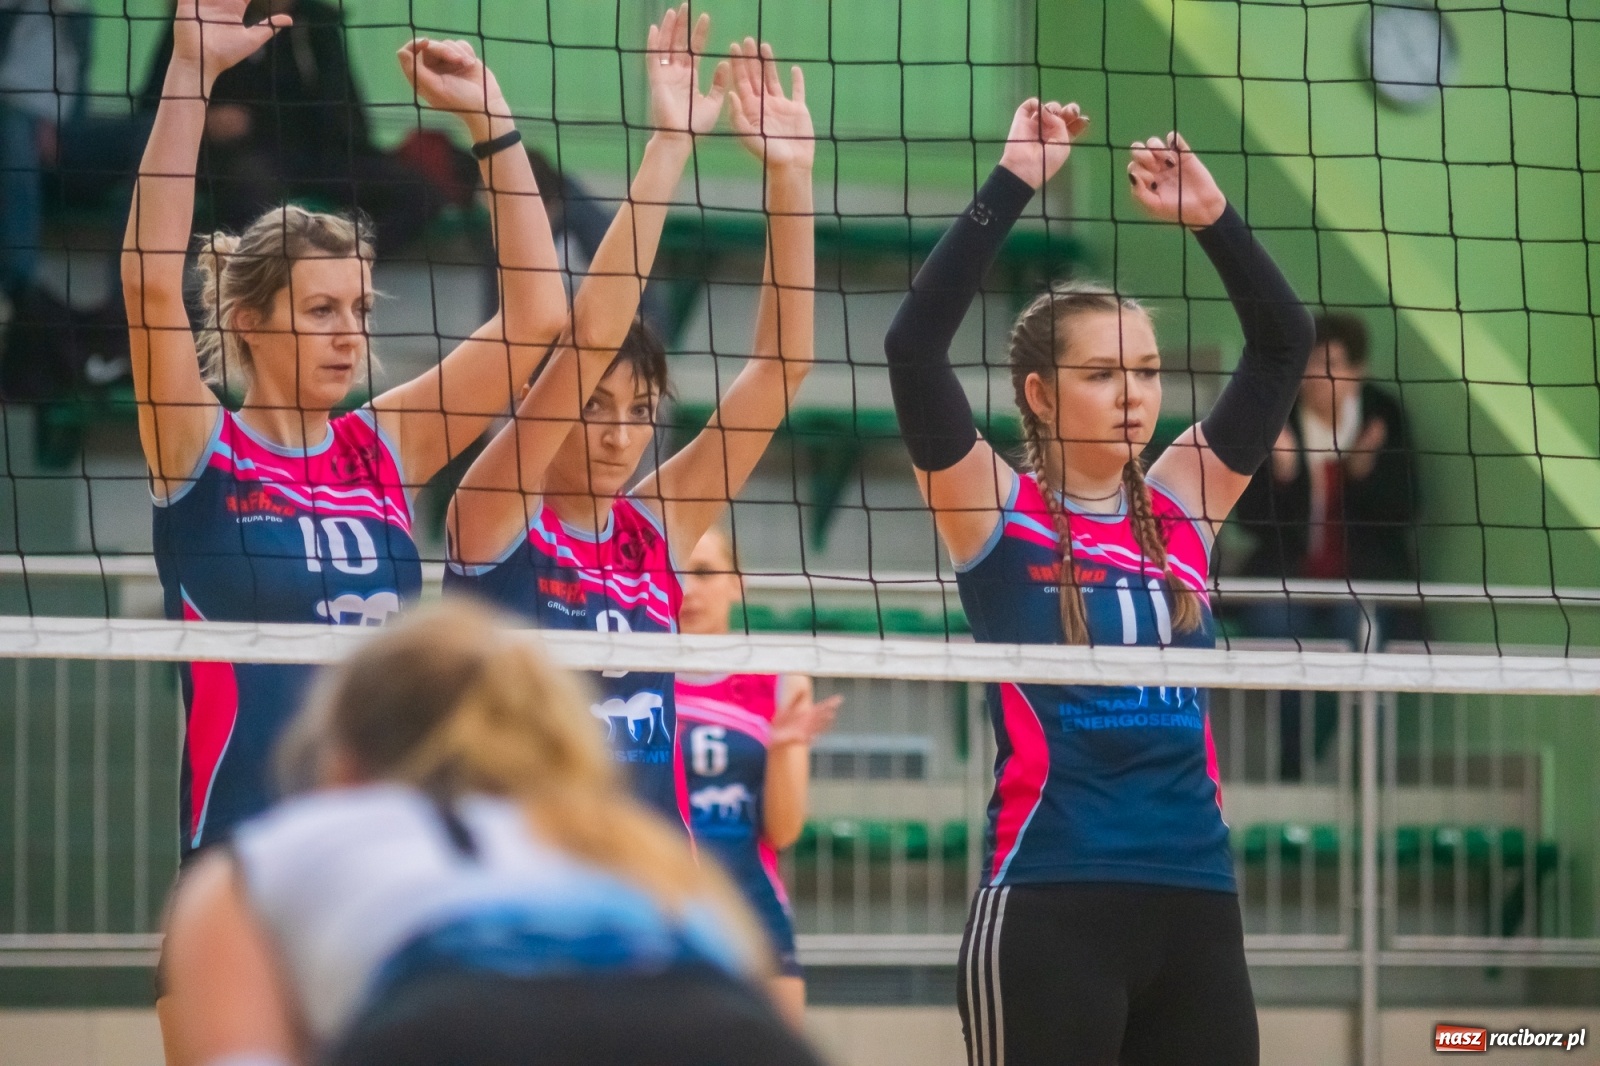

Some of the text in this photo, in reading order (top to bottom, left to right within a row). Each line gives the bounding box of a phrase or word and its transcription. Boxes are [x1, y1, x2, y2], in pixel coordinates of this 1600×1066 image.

[265, 515, 283, 523] PBG
[298, 516, 378, 575] 10
[571, 609, 587, 617] PBG
[1115, 577, 1172, 645] 11
[690, 725, 729, 777] 6
